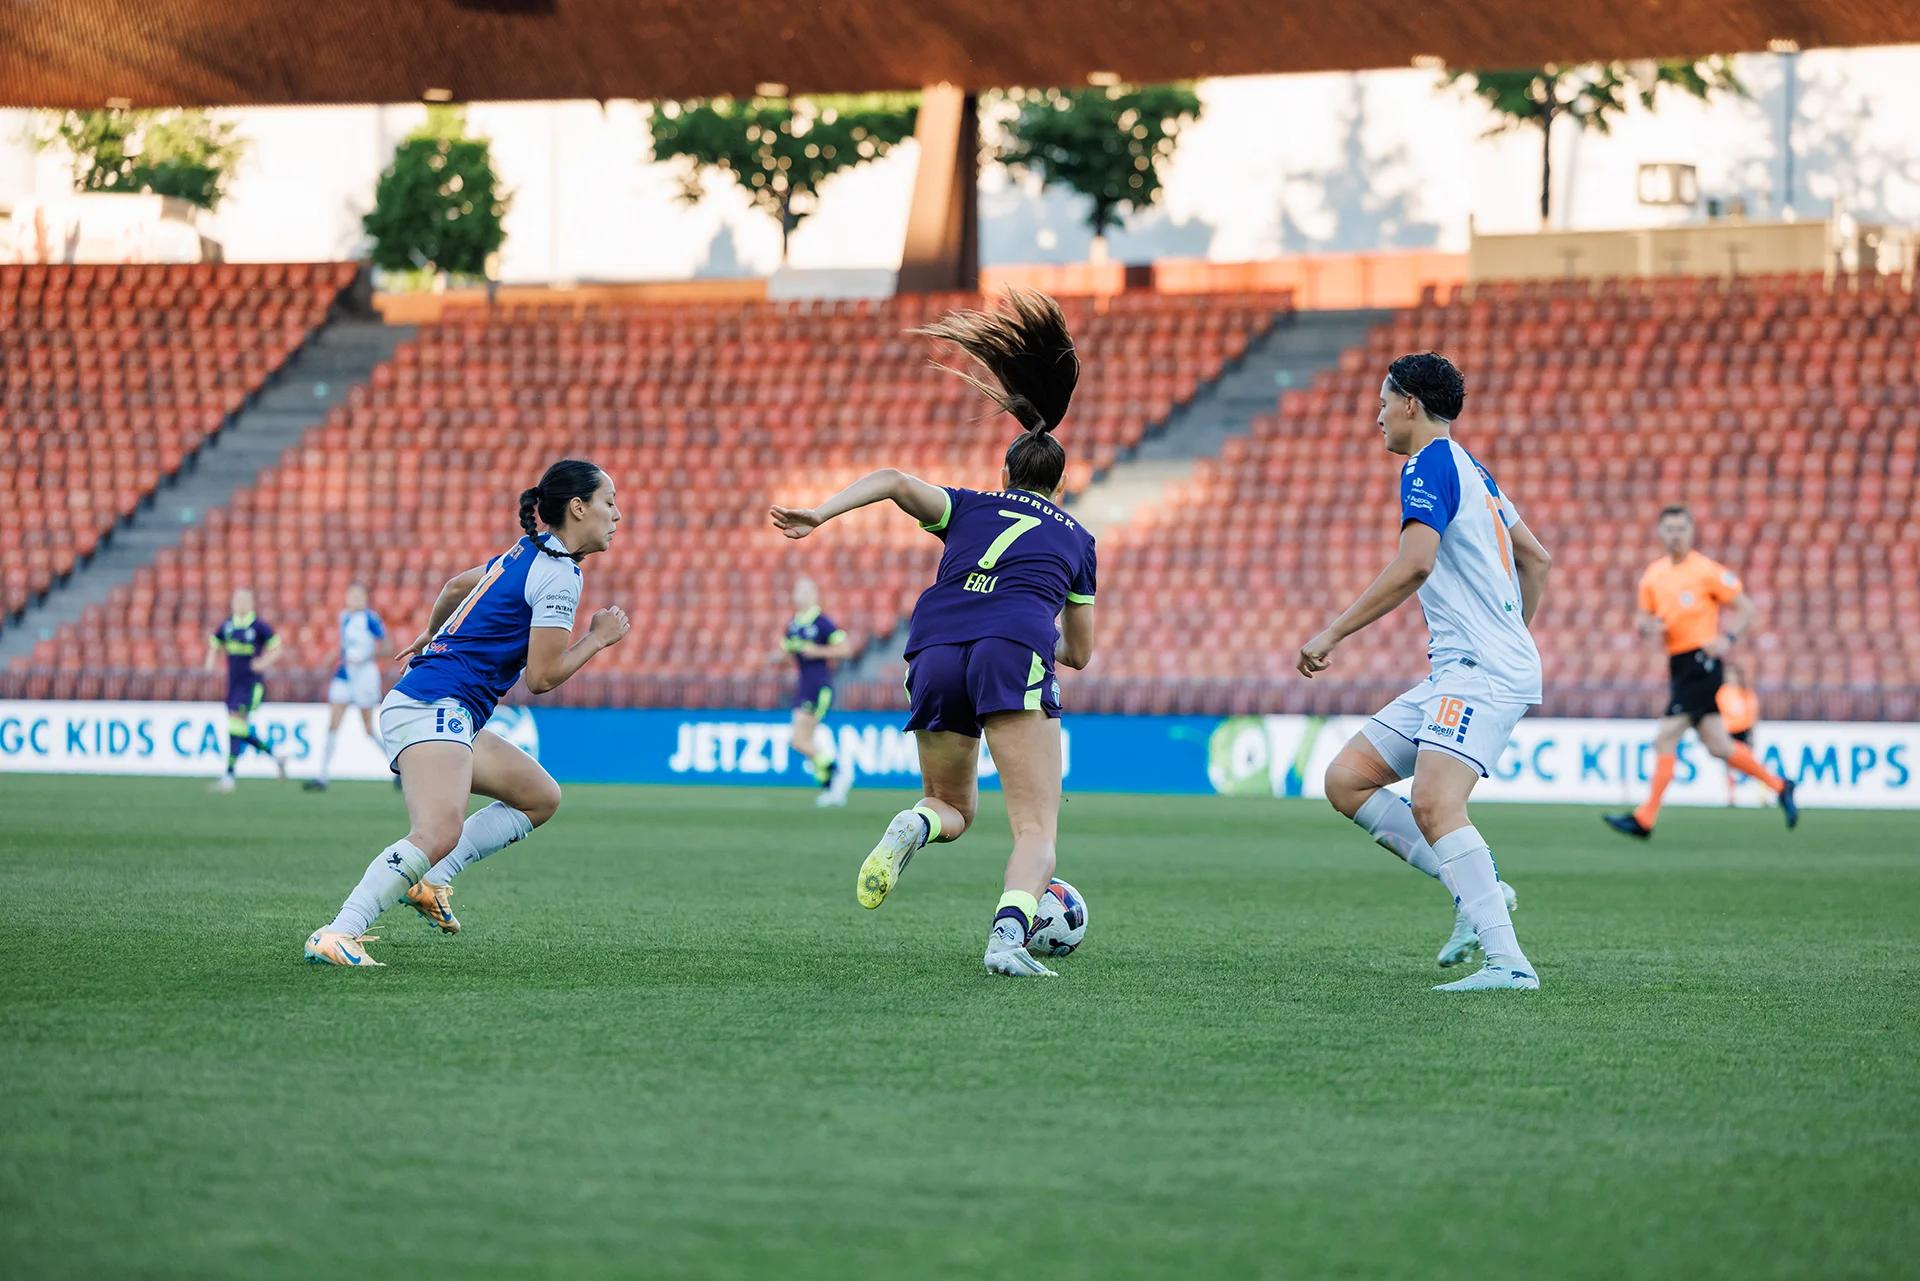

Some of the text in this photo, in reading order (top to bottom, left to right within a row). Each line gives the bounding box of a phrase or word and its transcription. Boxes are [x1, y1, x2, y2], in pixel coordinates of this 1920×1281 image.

[978, 509, 1042, 569] 7
[963, 572, 999, 593] EGLI
[1427, 724, 1455, 737] capelli
[1435, 695, 1465, 728] 16
[0, 719, 310, 758] GC KIDS CAPS
[669, 722, 794, 774] JETZT
[1736, 744, 1910, 788] AMPS
